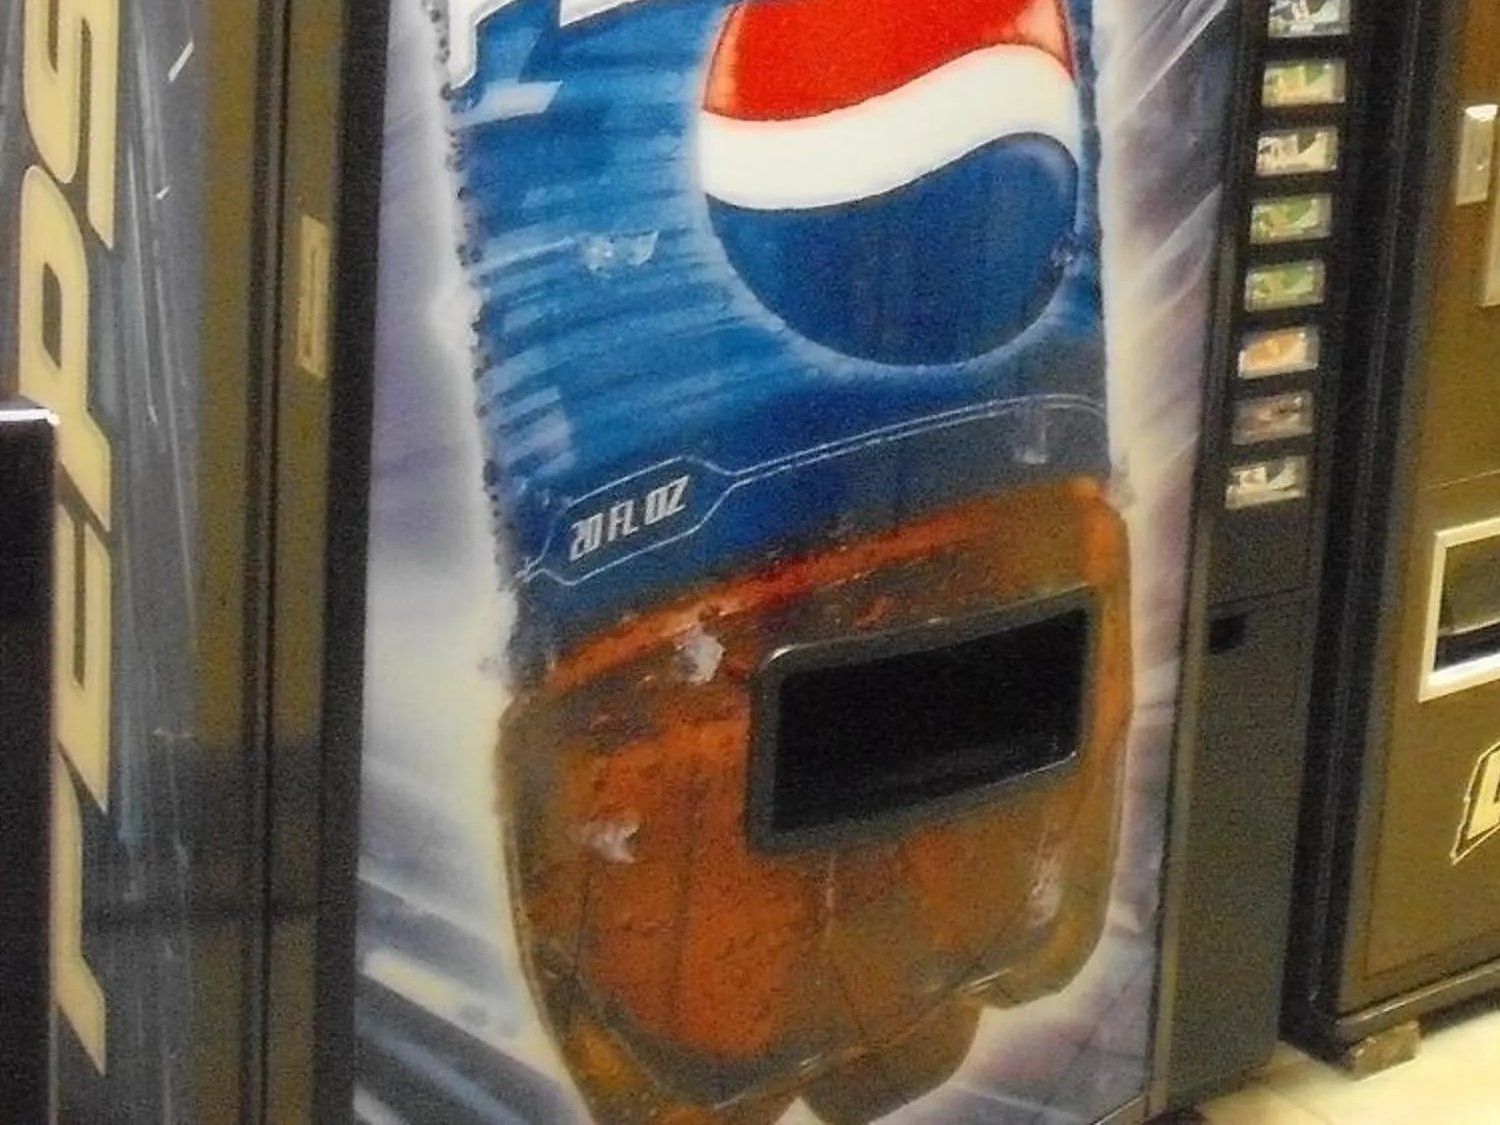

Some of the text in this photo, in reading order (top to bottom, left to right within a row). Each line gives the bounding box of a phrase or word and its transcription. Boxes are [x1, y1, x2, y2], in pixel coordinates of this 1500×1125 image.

[568, 474, 690, 562] 20 FL OZ
